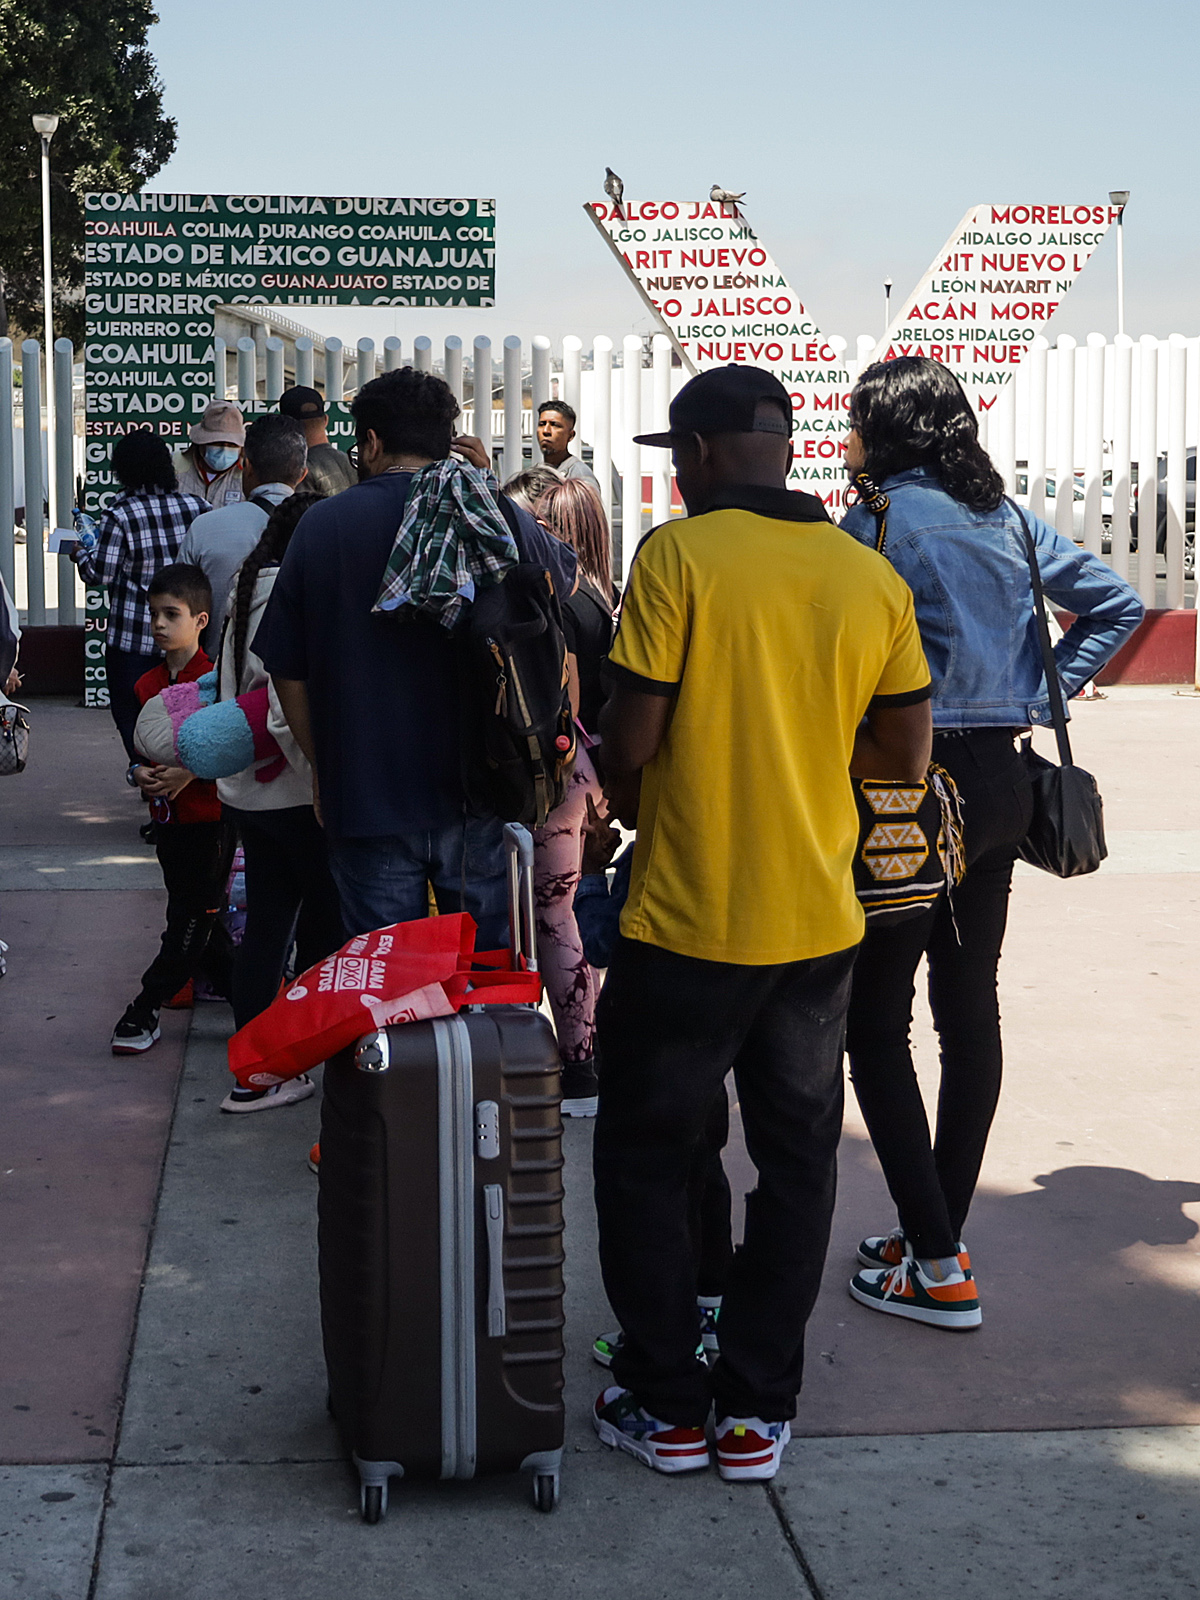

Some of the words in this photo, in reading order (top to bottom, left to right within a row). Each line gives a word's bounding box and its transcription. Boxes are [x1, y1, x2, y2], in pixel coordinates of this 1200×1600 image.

[84, 192, 219, 213] COAHUILA
[225, 195, 328, 215] COLIMA
[335, 197, 470, 217] DURANGO
[84, 221, 177, 237] COAHUILA
[182, 222, 254, 238] COLIMA
[258, 223, 354, 240] DURANGO
[358, 225, 452, 241] COAHUILA
[652, 227, 724, 243] JALISCO
[957, 231, 1032, 246] HIDALGO
[85, 242, 184, 264] ESTADO
[191, 244, 225, 265] DE
[231, 238, 331, 267] MÉXICO
[680, 248, 767, 269] NUEVO
[981, 253, 1066, 272] NUEVO
[84, 271, 154, 287] ESTADO
[158, 272, 182, 287] DE
[186, 268, 257, 288] MÉXICO
[261, 273, 388, 289] GUANAJUATO
[392, 275, 463, 290] ESTADO
[466, 275, 490, 290] DE
[647, 275, 709, 291] NUEVO
[713, 271, 759, 290] LEÓN
[931, 276, 976, 294] LEÓN
[980, 279, 1052, 294] NAYARIT
[691, 296, 792, 317] JALISCO
[907, 296, 977, 321] ACÁN
[85, 321, 181, 337] GUERRERO
[958, 328, 1035, 342] HIDALGO
[85, 343, 215, 365] COAHUILA
[697, 342, 784, 362] NUEVO
[973, 345, 1029, 364] NUE
[85, 371, 177, 387] COAHUILA
[86, 392, 186, 414] ESTADO
[159, 421, 182, 436] DE
[789, 467, 847, 480] AYARIT
[342, 958, 362, 988] OXXO
